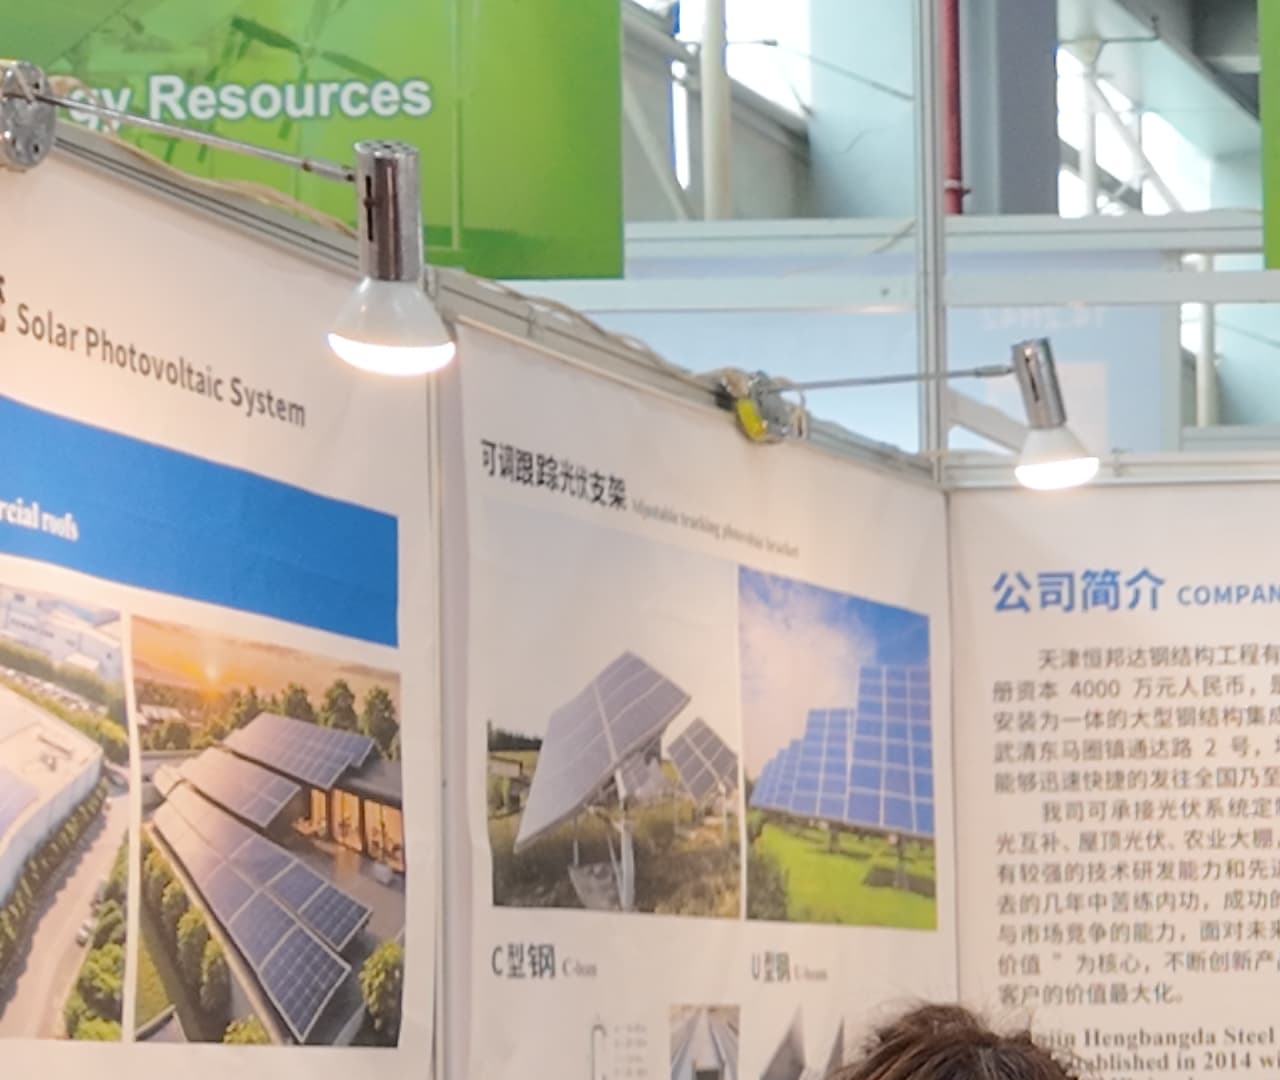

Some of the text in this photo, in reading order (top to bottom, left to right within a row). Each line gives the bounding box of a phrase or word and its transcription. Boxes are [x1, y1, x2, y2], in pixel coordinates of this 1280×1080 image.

[148, 74, 432, 121] Resources
[17, 302, 306, 428] Solar Photovoltaic System
[992, 567, 1165, 613] 公司简介
[1084, 1026, 1216, 1051] Hengbangda
[1223, 1026, 1274, 1045] Steel
